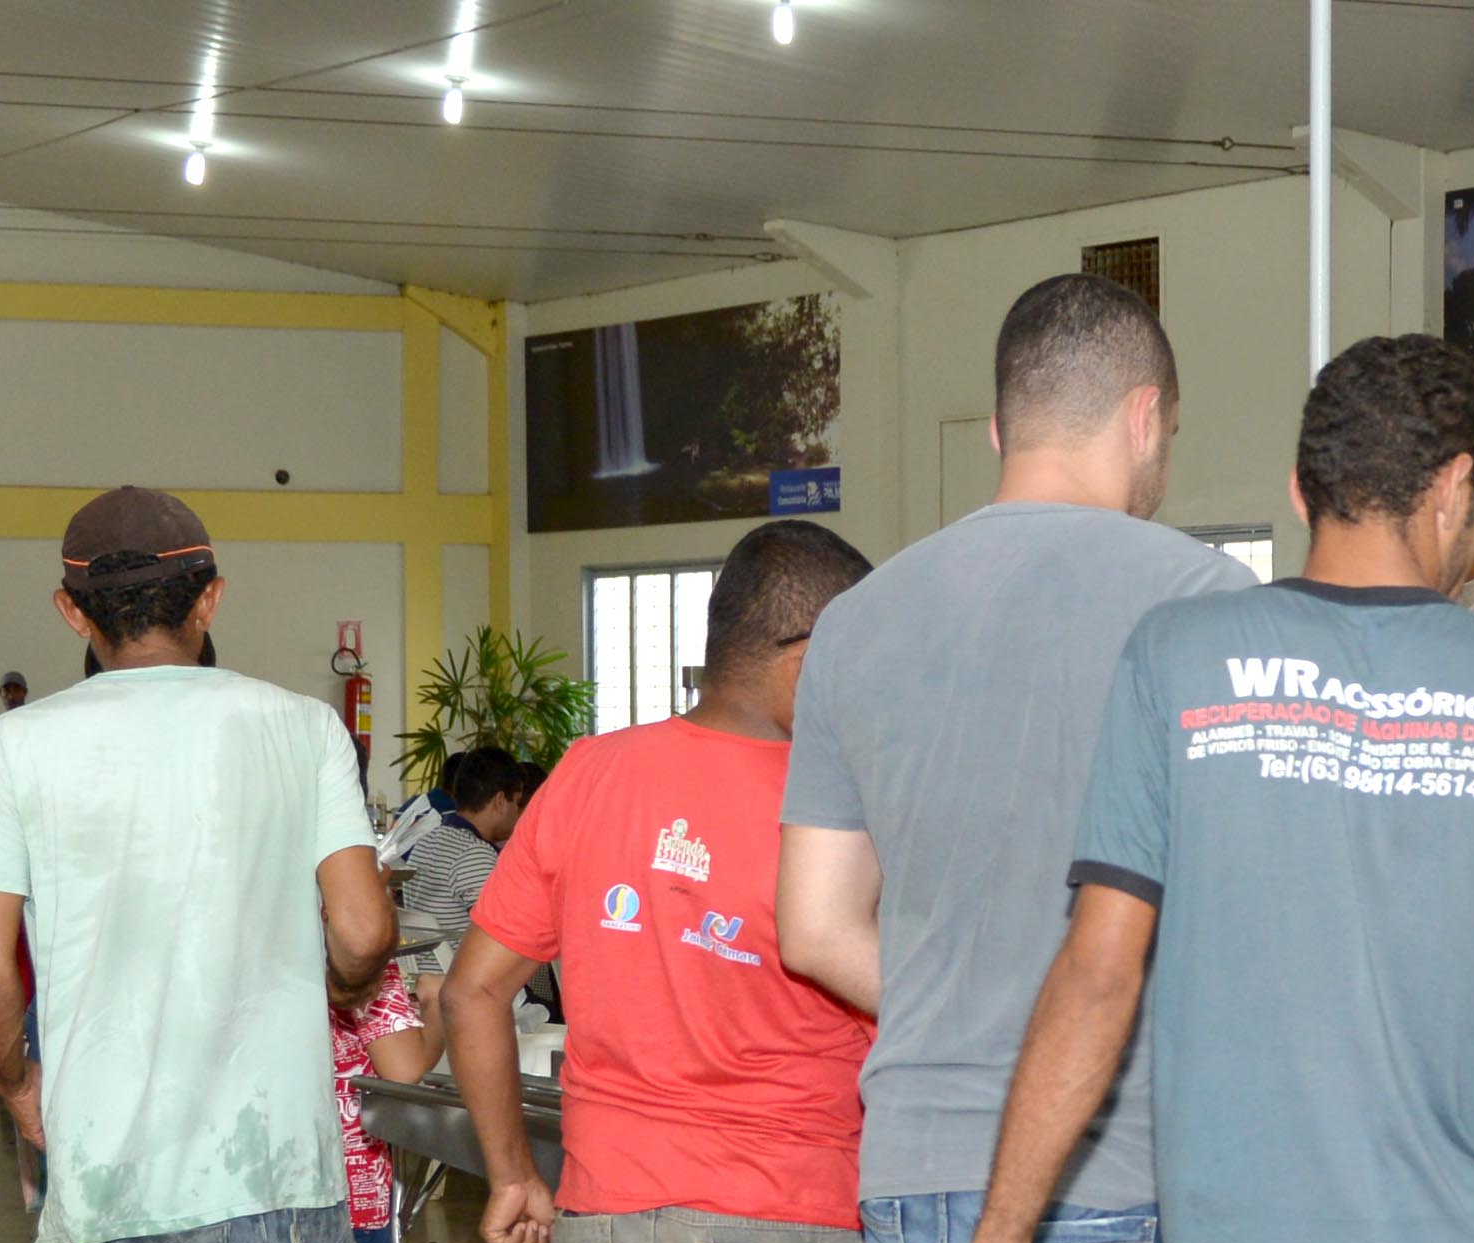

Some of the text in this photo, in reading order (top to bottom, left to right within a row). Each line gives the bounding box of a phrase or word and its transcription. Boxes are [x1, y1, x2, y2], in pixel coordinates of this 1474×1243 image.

[1226, 657, 1320, 698] WR
[1180, 701, 1331, 730] RECUPERAÇÃO
[1333, 709, 1358, 732] DE
[1186, 745, 1207, 760] DE
[1208, 739, 1255, 755] VIDROS
[1402, 756, 1443, 770] OBRA
[1191, 724, 1255, 745] ALARMES
[1264, 724, 1319, 739] TRAVAS
[1408, 743, 1429, 756] DE
